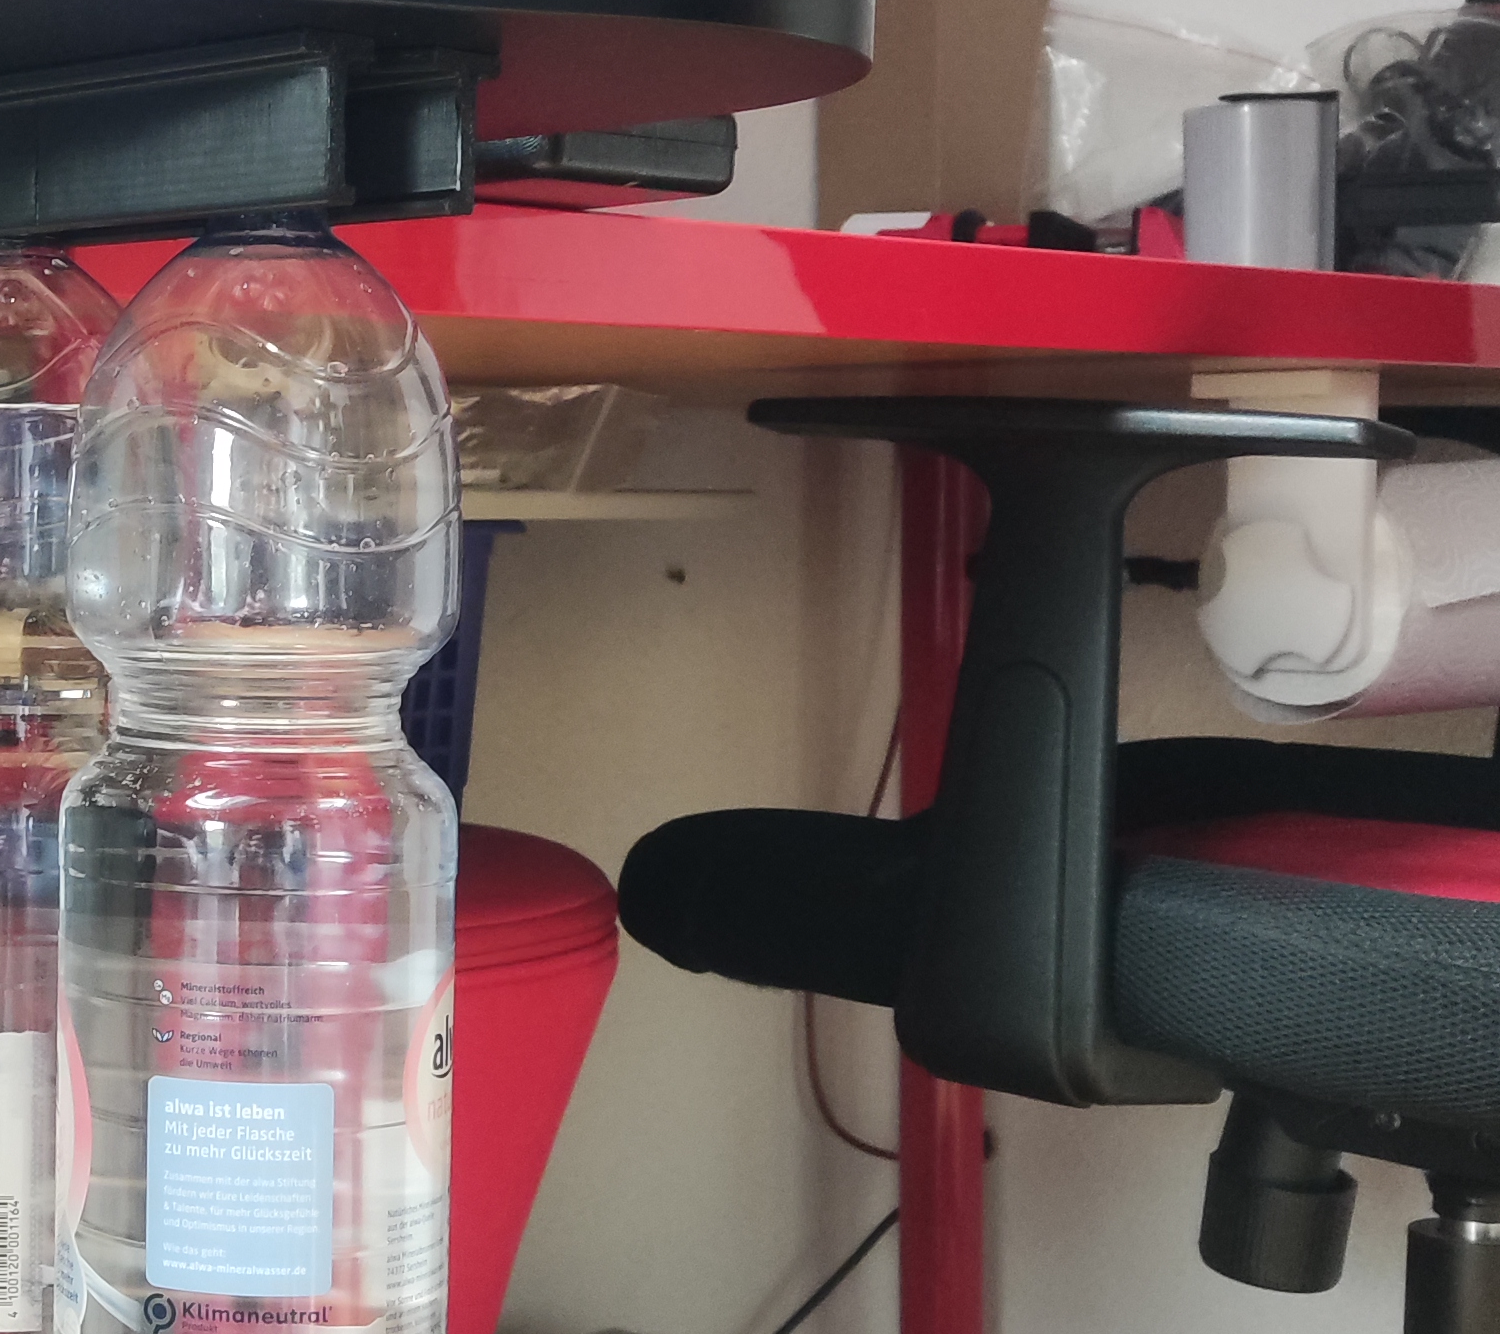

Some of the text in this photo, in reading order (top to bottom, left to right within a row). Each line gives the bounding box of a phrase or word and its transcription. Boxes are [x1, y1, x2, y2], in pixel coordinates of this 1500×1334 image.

[180, 982, 266, 996] Mineralstoffreich
[180, 1030, 222, 1044] Regional
[209, 1046, 235, 1060] Wege
[165, 1098, 285, 1120] alwa ist leben
[165, 1120, 295, 1142] Mit jeder Flasche
[165, 1142, 313, 1162] zu mehr Glückszeit
[163, 1169, 317, 1189] Zusammen mit der alwa Stiftung
[163, 1184, 312, 1204] fördern wir Eure Leidenschaften
[210, 1204, 224, 1216] für
[226, 1207, 251, 1217] mehr
[253, 1208, 320, 1221] Glücksgefühle
[9, 1200, 19, 1248] 001164
[163, 1216, 180, 1228] und
[182, 1218, 236, 1232] Optimismus
[238, 1221, 248, 1233] in
[250, 1223, 285, 1234] unserer
[163, 1241, 227, 1259] Wie das geht:
[163, 1259, 307, 1276] www.alwa-mineralwasser.de
[7, 1254, 19, 1300] 100120
[181, 1322, 218, 1334] Produkt
